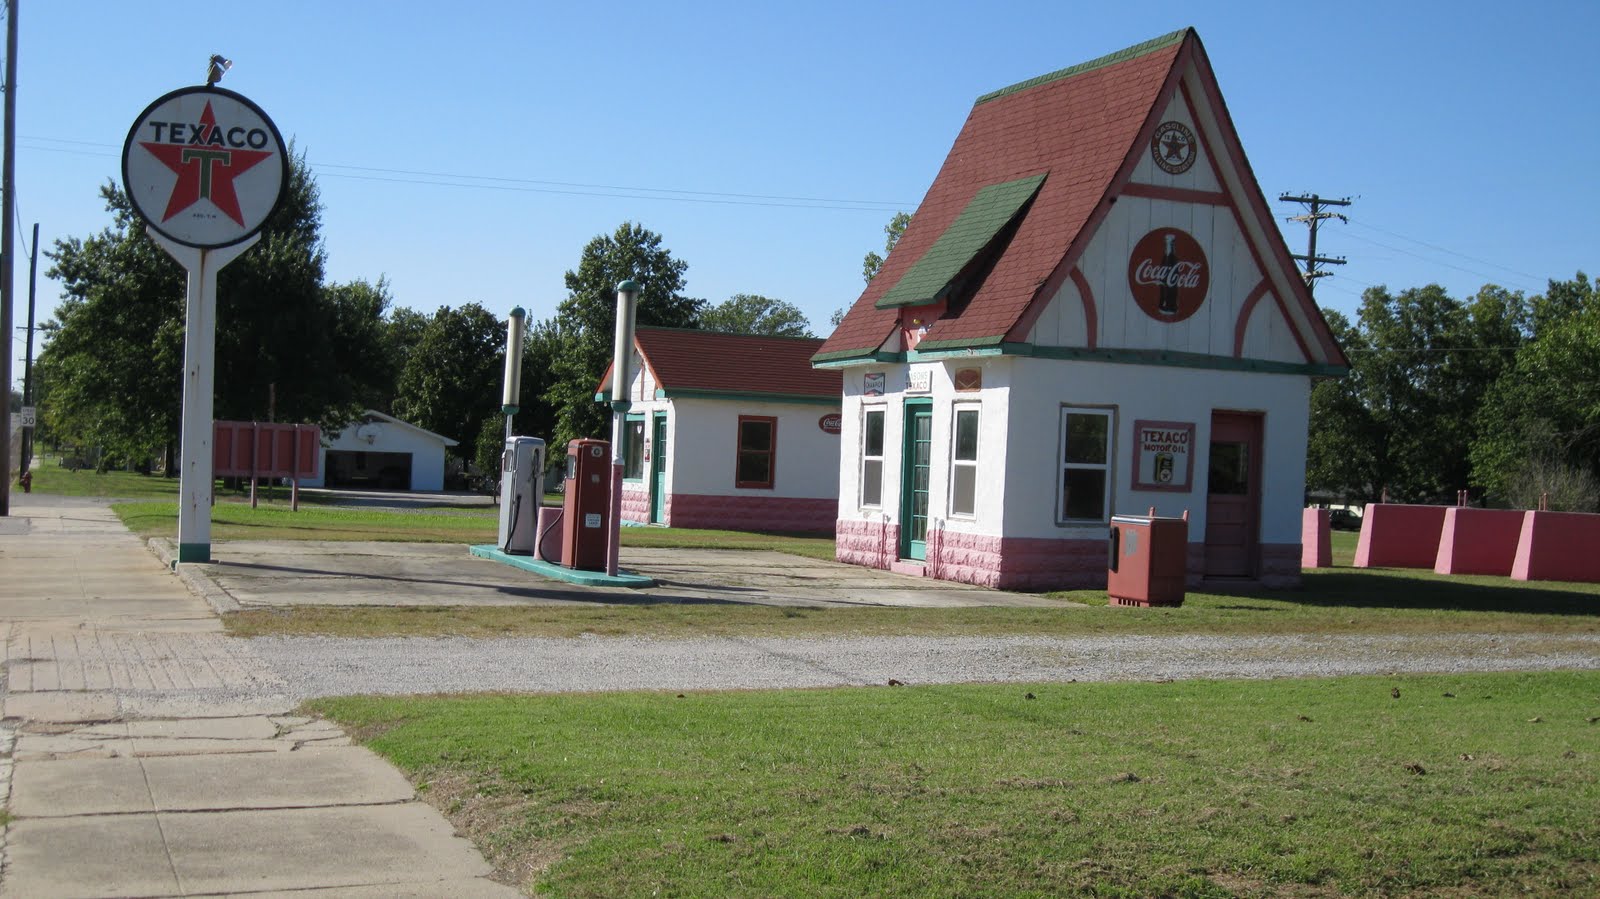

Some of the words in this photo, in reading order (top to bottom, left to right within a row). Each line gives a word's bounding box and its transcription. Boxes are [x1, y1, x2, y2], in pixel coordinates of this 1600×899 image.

[149, 121, 268, 149] TEXACO
[1154, 122, 1195, 144] GASOLINE
[181, 148, 232, 201] T
[1135, 259, 1202, 289] Coca-Cola
[22, 416, 35, 425] 30
[1142, 430, 1188, 444] TEXACO
[1144, 444, 1172, 452] MOTOR
[1172, 446, 1186, 454] OIL
